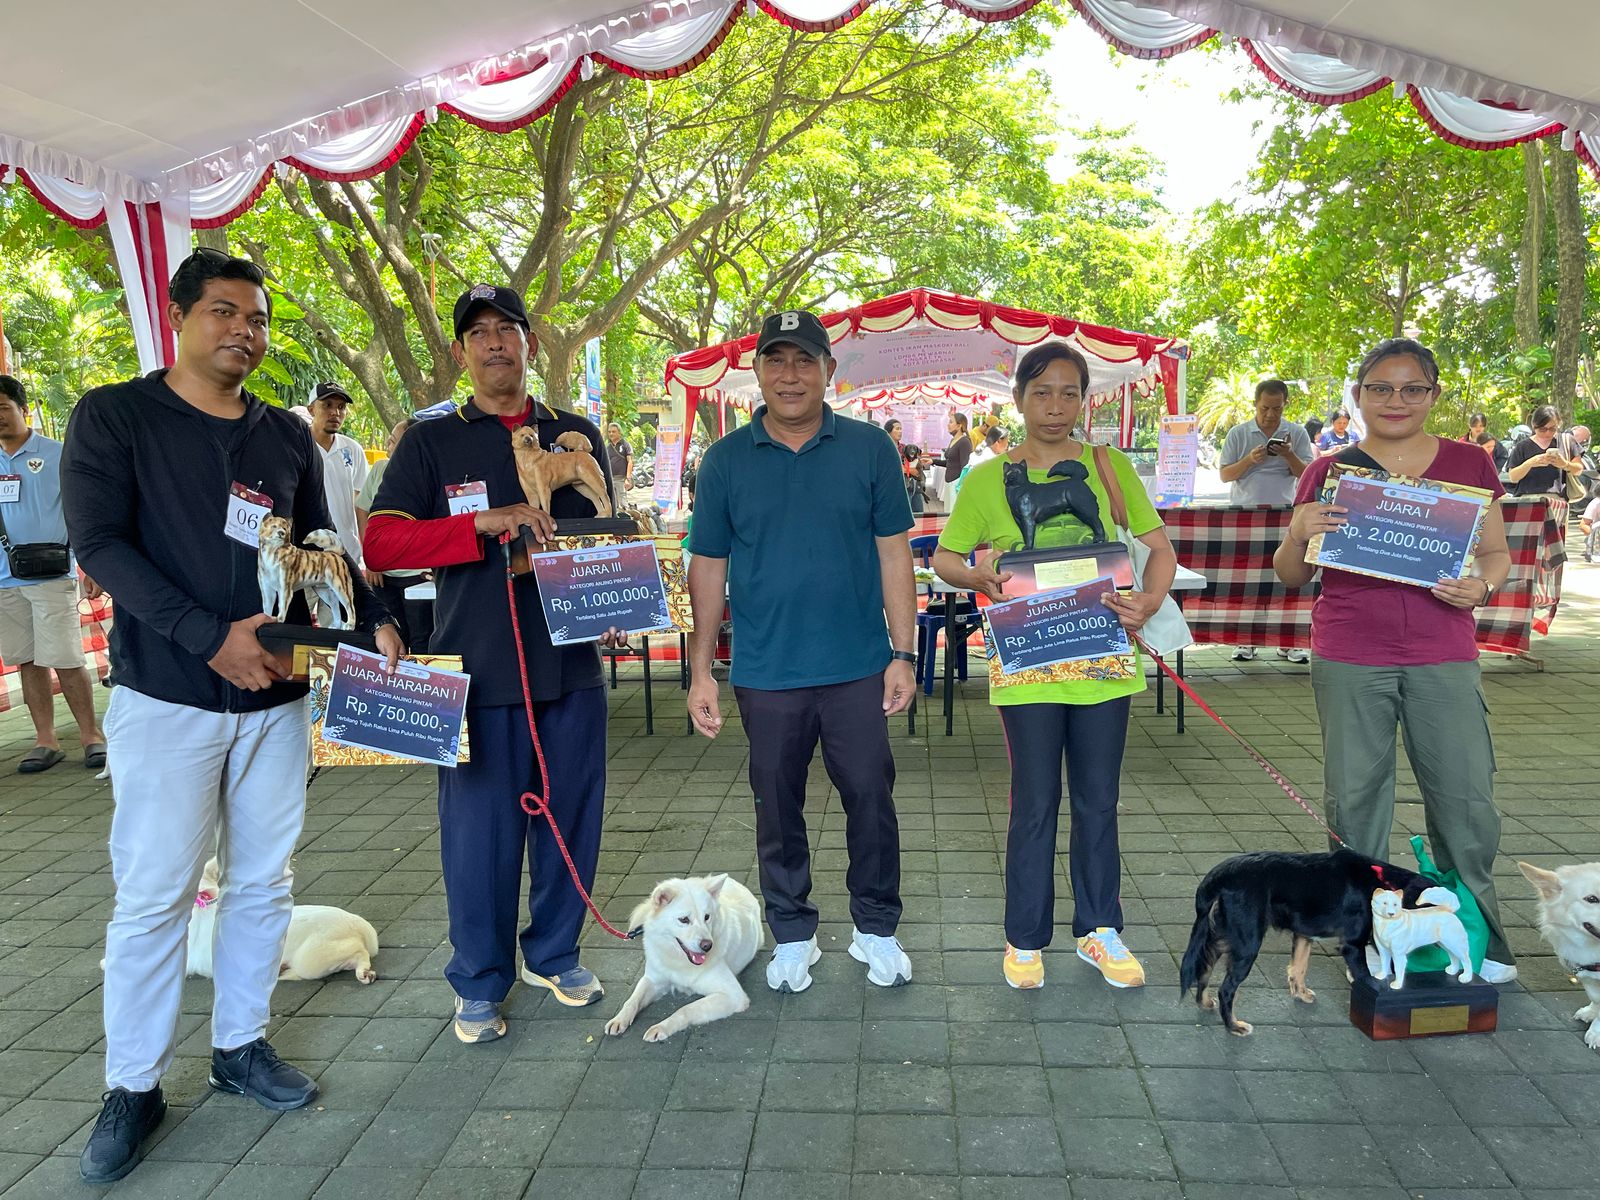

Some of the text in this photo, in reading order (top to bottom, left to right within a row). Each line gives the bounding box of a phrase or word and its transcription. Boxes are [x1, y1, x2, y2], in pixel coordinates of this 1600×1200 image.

[780, 312, 799, 330] B
[4, 485, 15, 494] 07
[1376, 500, 1430, 518] JUARA I
[237, 509, 258, 530] 06
[1364, 514, 1438, 533] KATEGORI ANJING PINTAR
[1336, 523, 1462, 558] Rp. 2.000.000,-
[570, 562, 622, 578] JUARA III
[570, 582, 594, 590] KATEGORI
[551, 586, 659, 613] Rp. 1.000.000,-
[1026, 601, 1067, 618] JUARA
[1023, 608, 1088, 628] KATEGORI ANJING PINTAR
[1004, 616, 1118, 650] Rp. 1.500.000,-
[342, 664, 383, 684] JUARA
[386, 675, 449, 699] HARAPAN
[453, 690, 456, 700] I
[365, 688, 432, 708] KATEGORI ANJING PINTAR
[345, 696, 449, 732] Rp. 750.000,-
